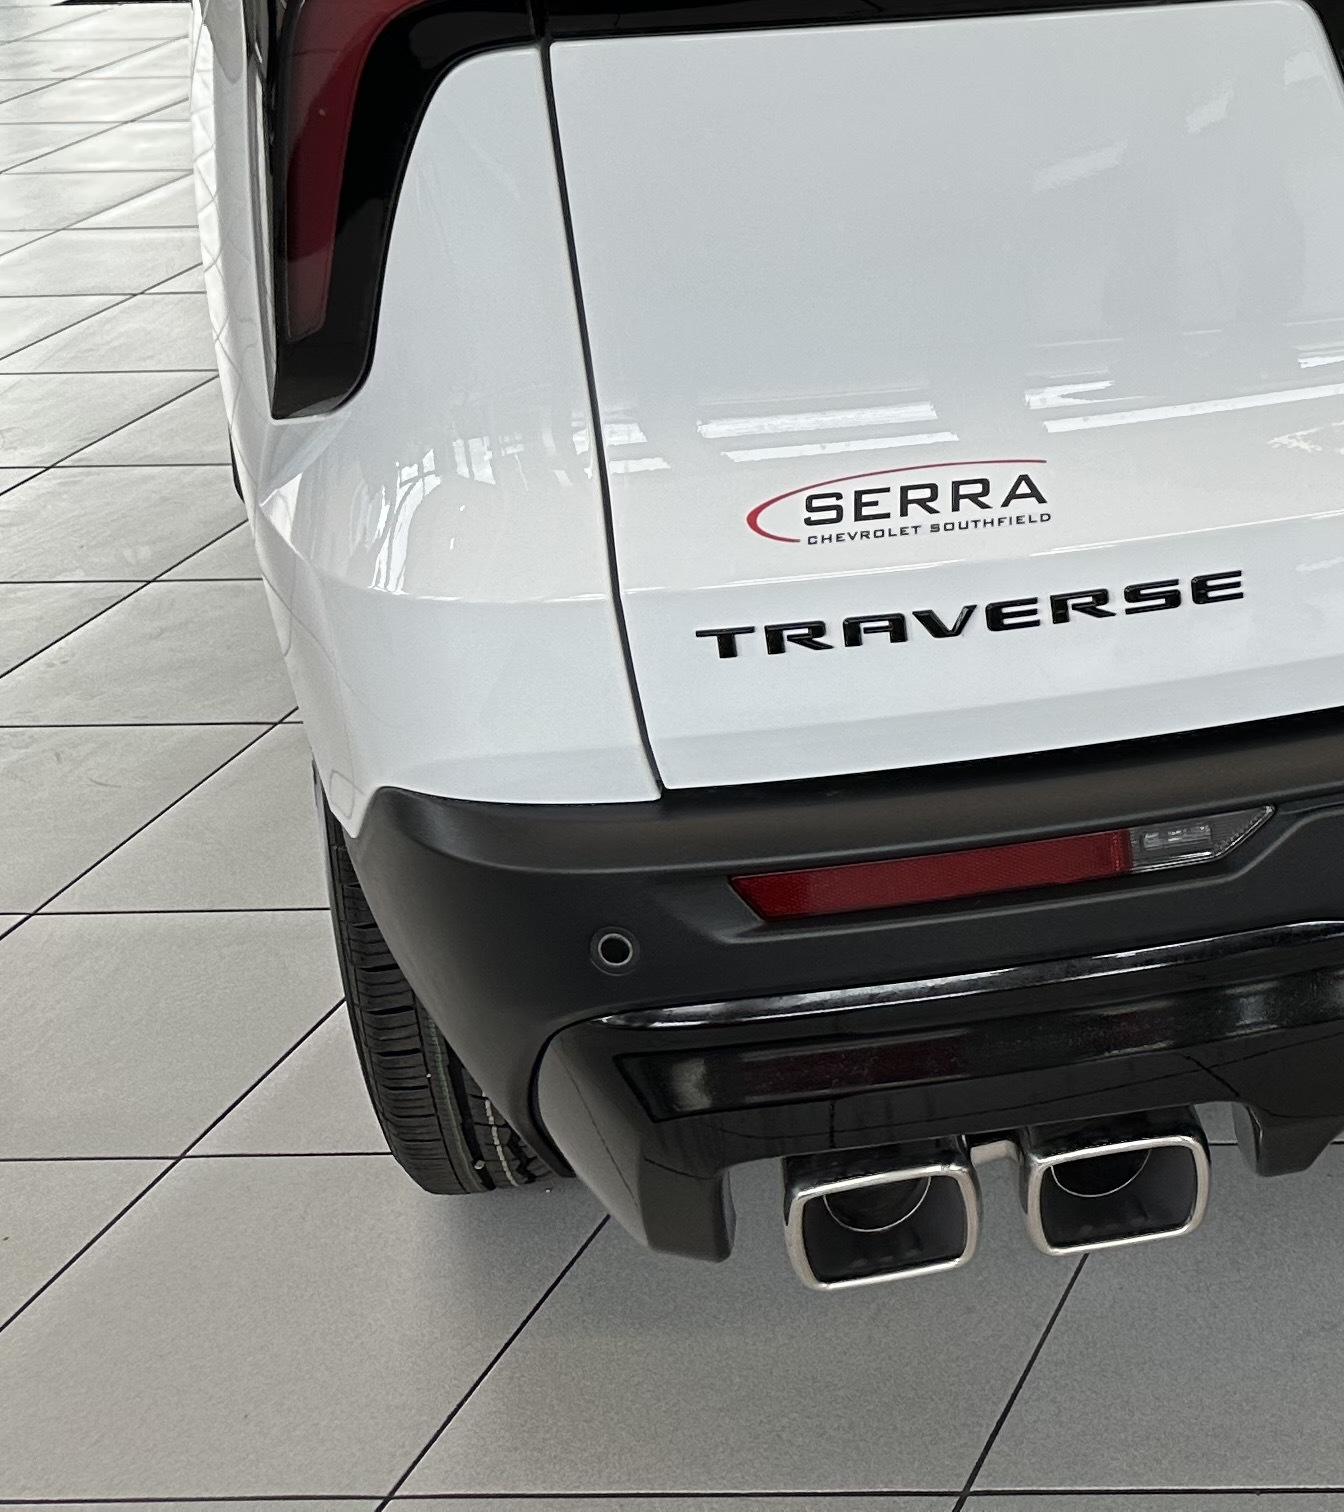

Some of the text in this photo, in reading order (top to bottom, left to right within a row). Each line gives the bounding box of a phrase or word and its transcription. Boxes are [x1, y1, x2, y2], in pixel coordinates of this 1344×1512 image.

[803, 473, 1048, 528] SERRA
[806, 512, 1052, 546] CHEVROLET SOUTHFIELD
[695, 569, 1245, 660] TRAVERSE
